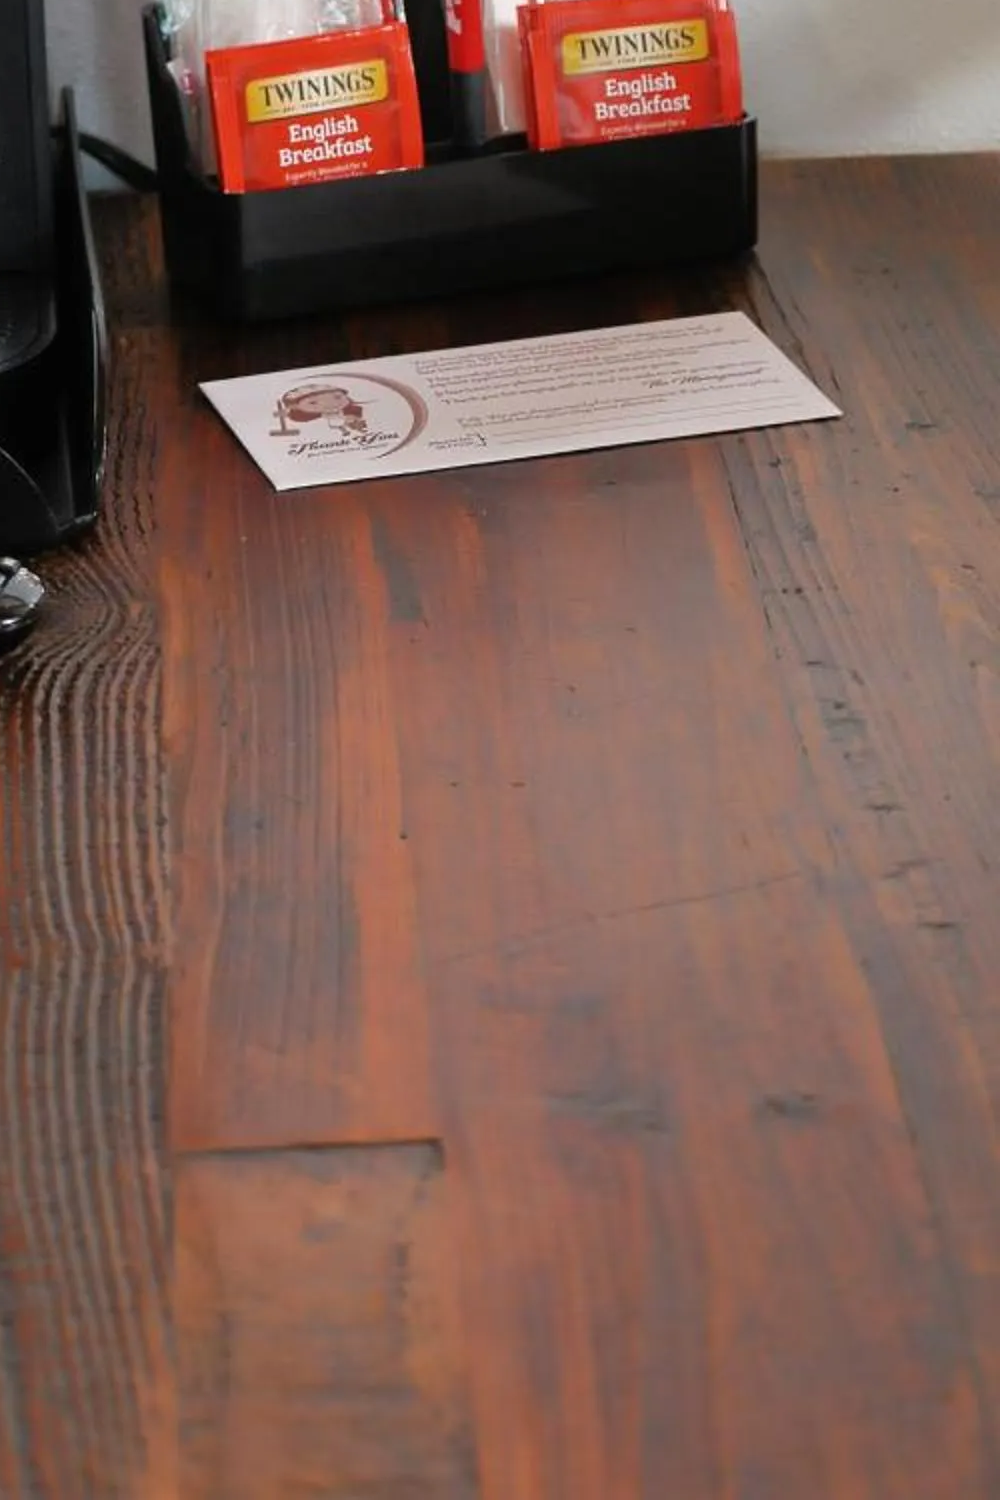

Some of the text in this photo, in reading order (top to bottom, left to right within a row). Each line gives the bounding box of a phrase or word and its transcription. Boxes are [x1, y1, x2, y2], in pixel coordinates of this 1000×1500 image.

[575, 29, 696, 61] TWININGS
[259, 69, 376, 106] TWININGS
[604, 72, 676, 101] English
[594, 94, 691, 121] Breakfast
[288, 115, 359, 143] English
[279, 135, 373, 168] Breakfast
